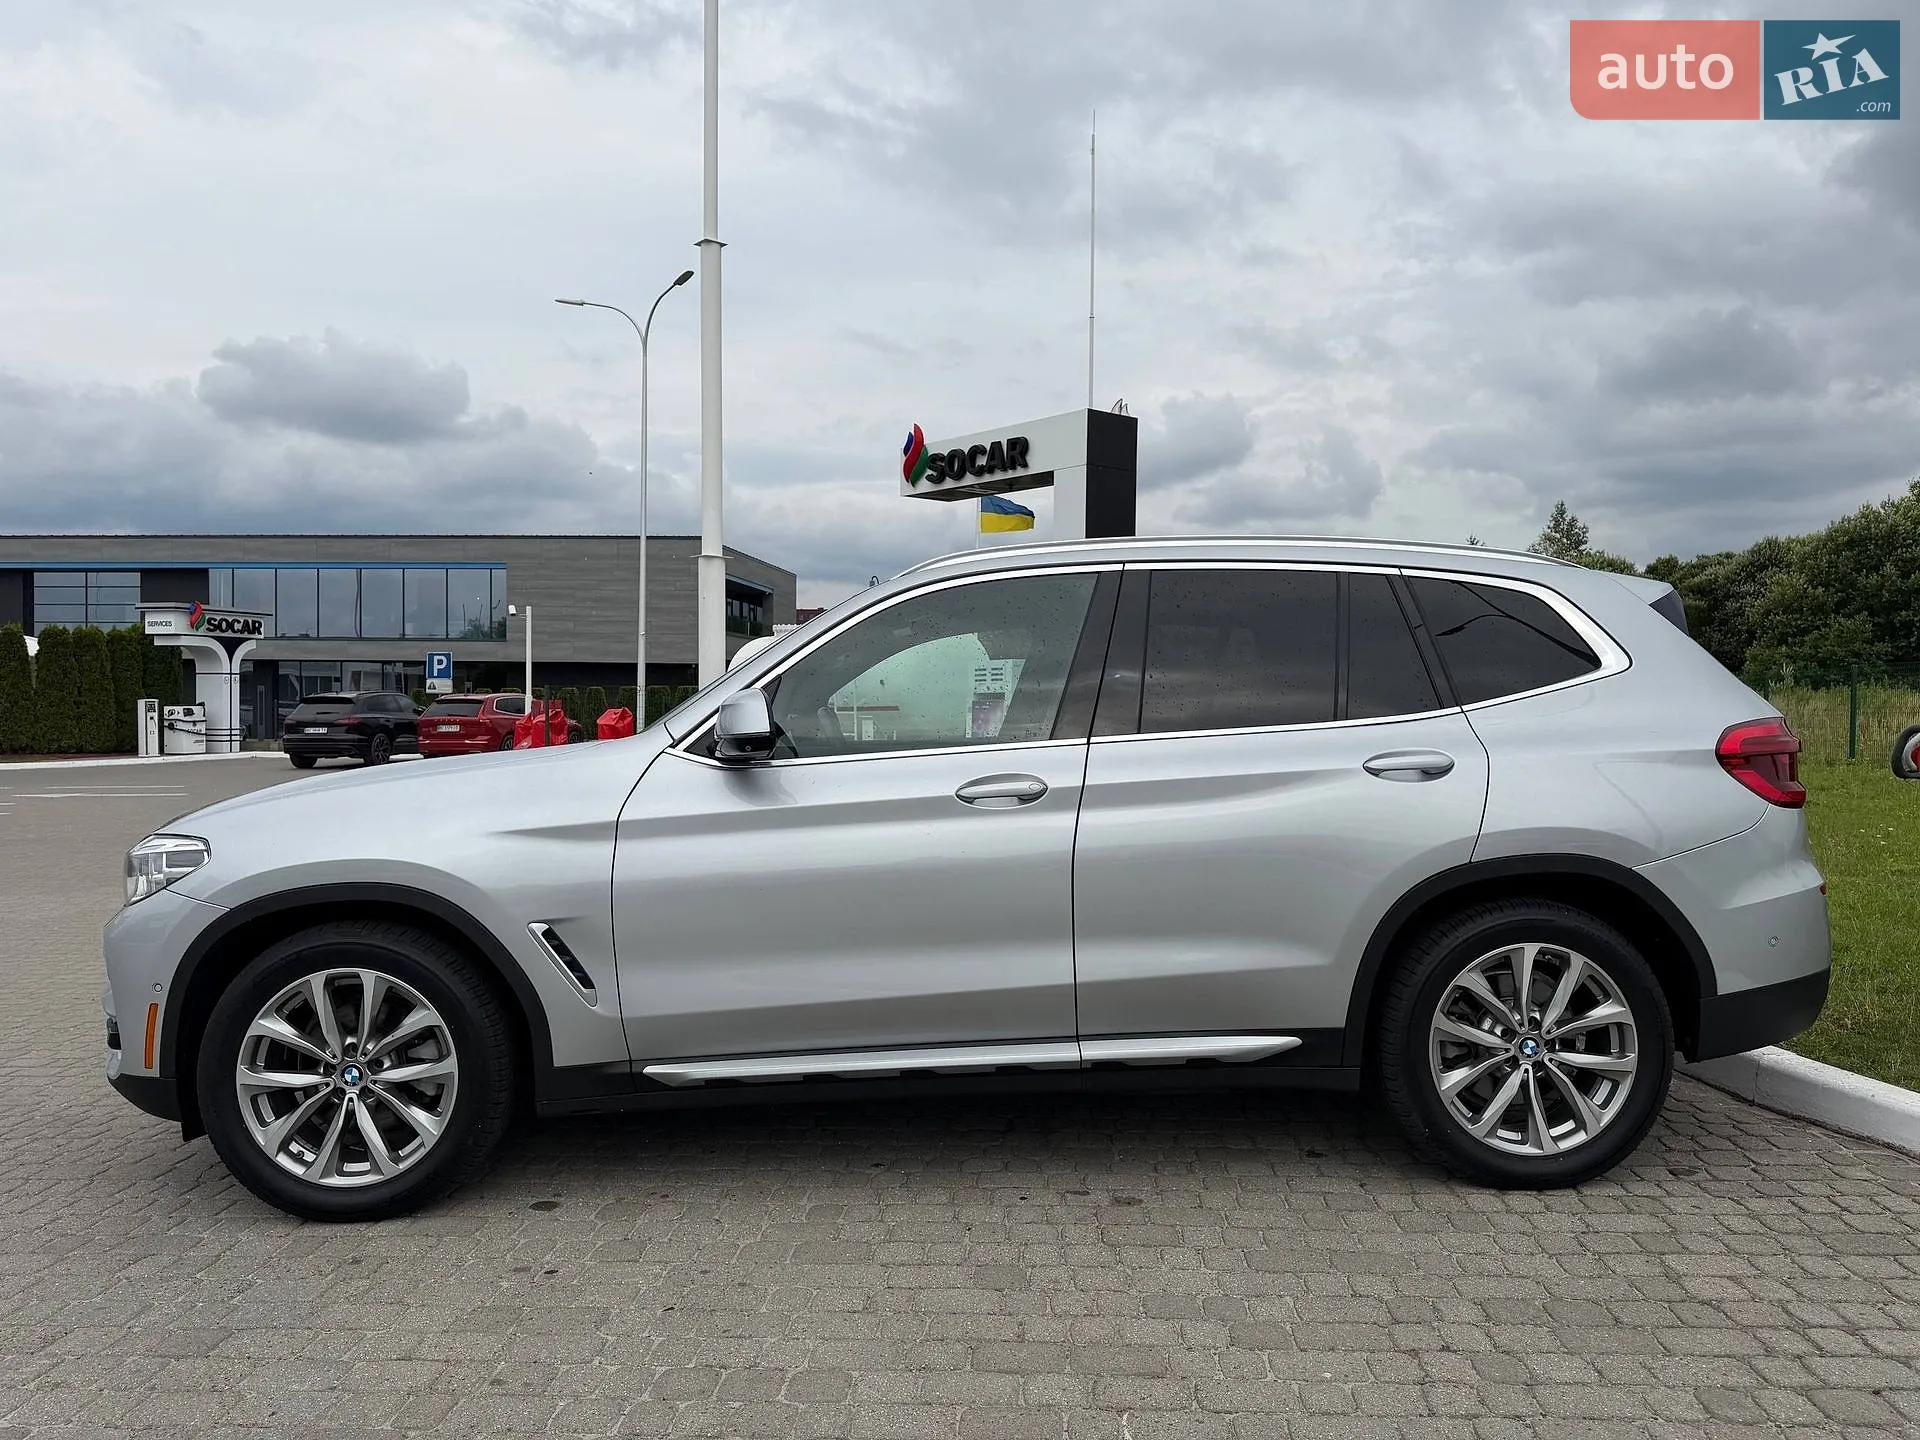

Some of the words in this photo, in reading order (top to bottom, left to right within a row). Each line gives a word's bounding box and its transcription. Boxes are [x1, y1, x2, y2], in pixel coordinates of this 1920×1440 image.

[925, 436, 1029, 484] SOCAR
[205, 616, 263, 635] SOCAR
[433, 655, 447, 677] P
